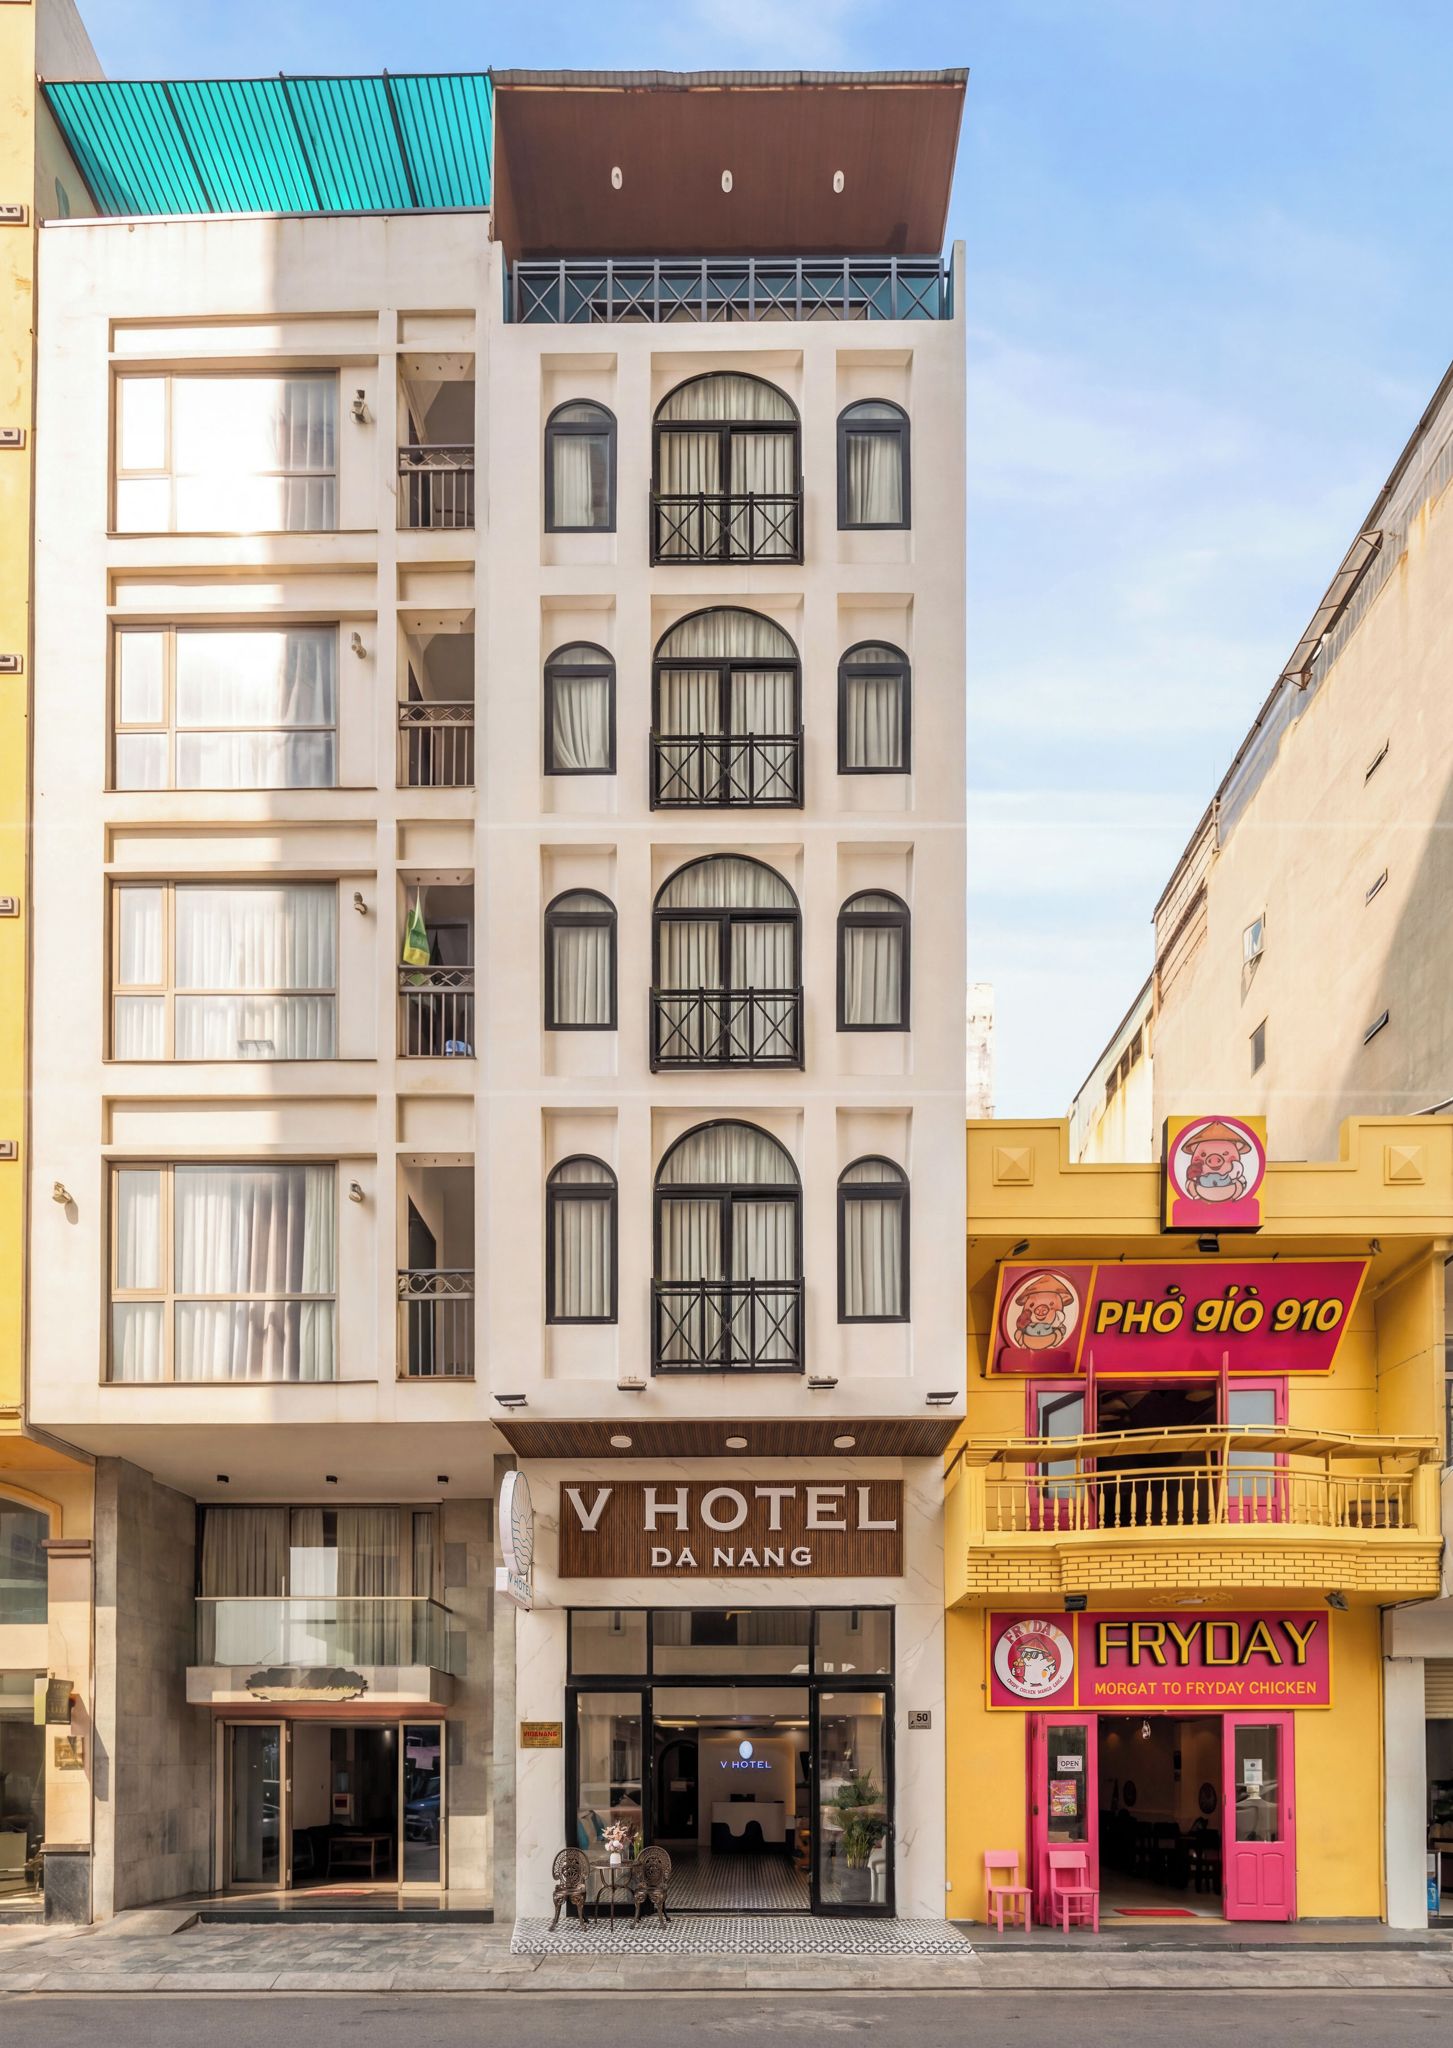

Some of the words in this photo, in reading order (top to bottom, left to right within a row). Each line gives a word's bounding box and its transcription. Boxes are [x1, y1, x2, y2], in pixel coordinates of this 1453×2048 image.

[1095, 1285, 1186, 1334] PHỞ
[1271, 1298, 1345, 1333] 910
[564, 1488, 613, 1532] V
[643, 1485, 897, 1532] HOTEL
[651, 1547, 698, 1568] DA
[713, 1547, 813, 1568] NANG
[1004, 1620, 1063, 1644] FRYDAY
[1098, 1620, 1318, 1666] FRYDAY
[1095, 1682, 1157, 1695] MORGAT
[1162, 1682, 1182, 1695] TO
[1186, 1681, 1245, 1695] FRYDAY
[1249, 1681, 1317, 1694] CHICKEN
[916, 1713, 928, 1722] 50
[720, 1761, 728, 1769] V
[732, 1761, 772, 1769] HOTEL
